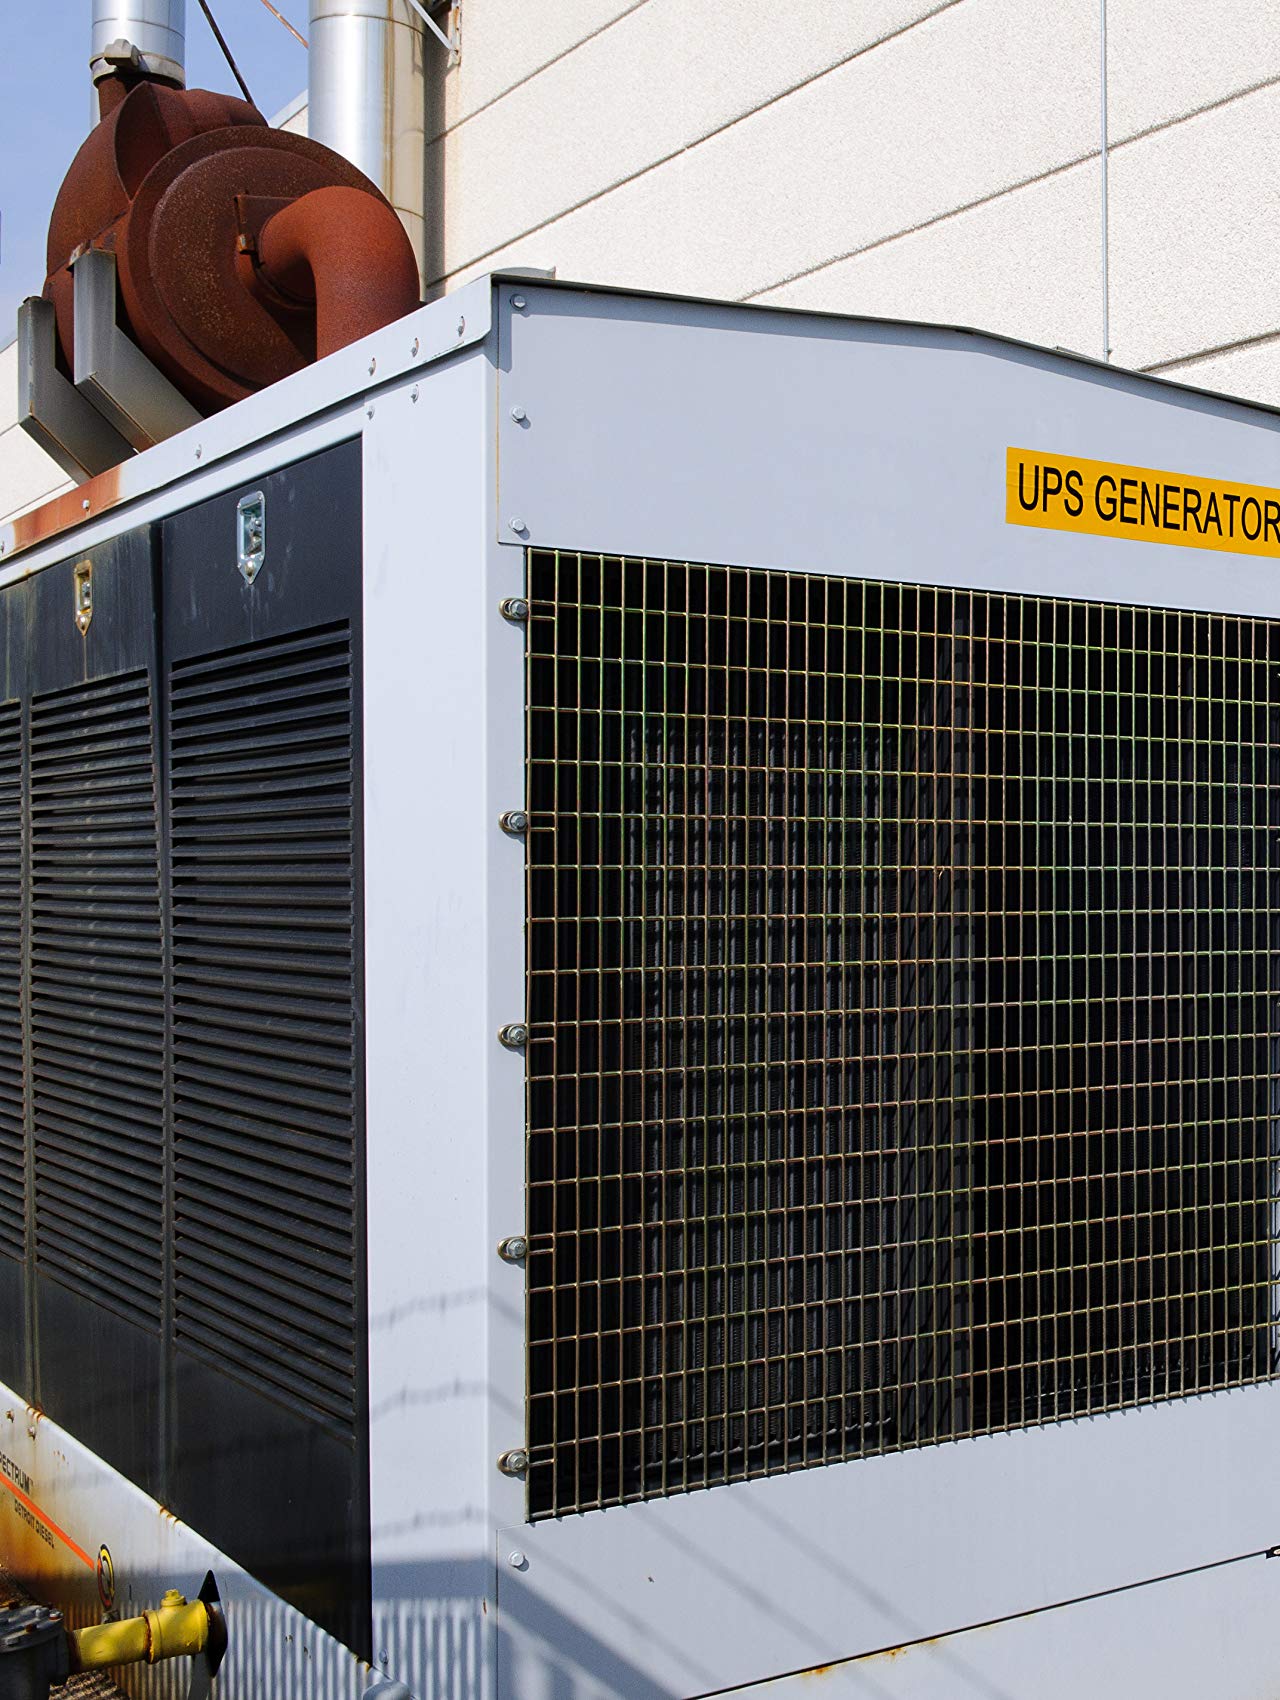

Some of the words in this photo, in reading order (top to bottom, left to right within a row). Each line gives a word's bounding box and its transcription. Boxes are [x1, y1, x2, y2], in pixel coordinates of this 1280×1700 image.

[1018, 462, 1084, 517] UPS
[14, 1498, 35, 1529] DETROIT
[36, 1519, 55, 1549] DIESEL
